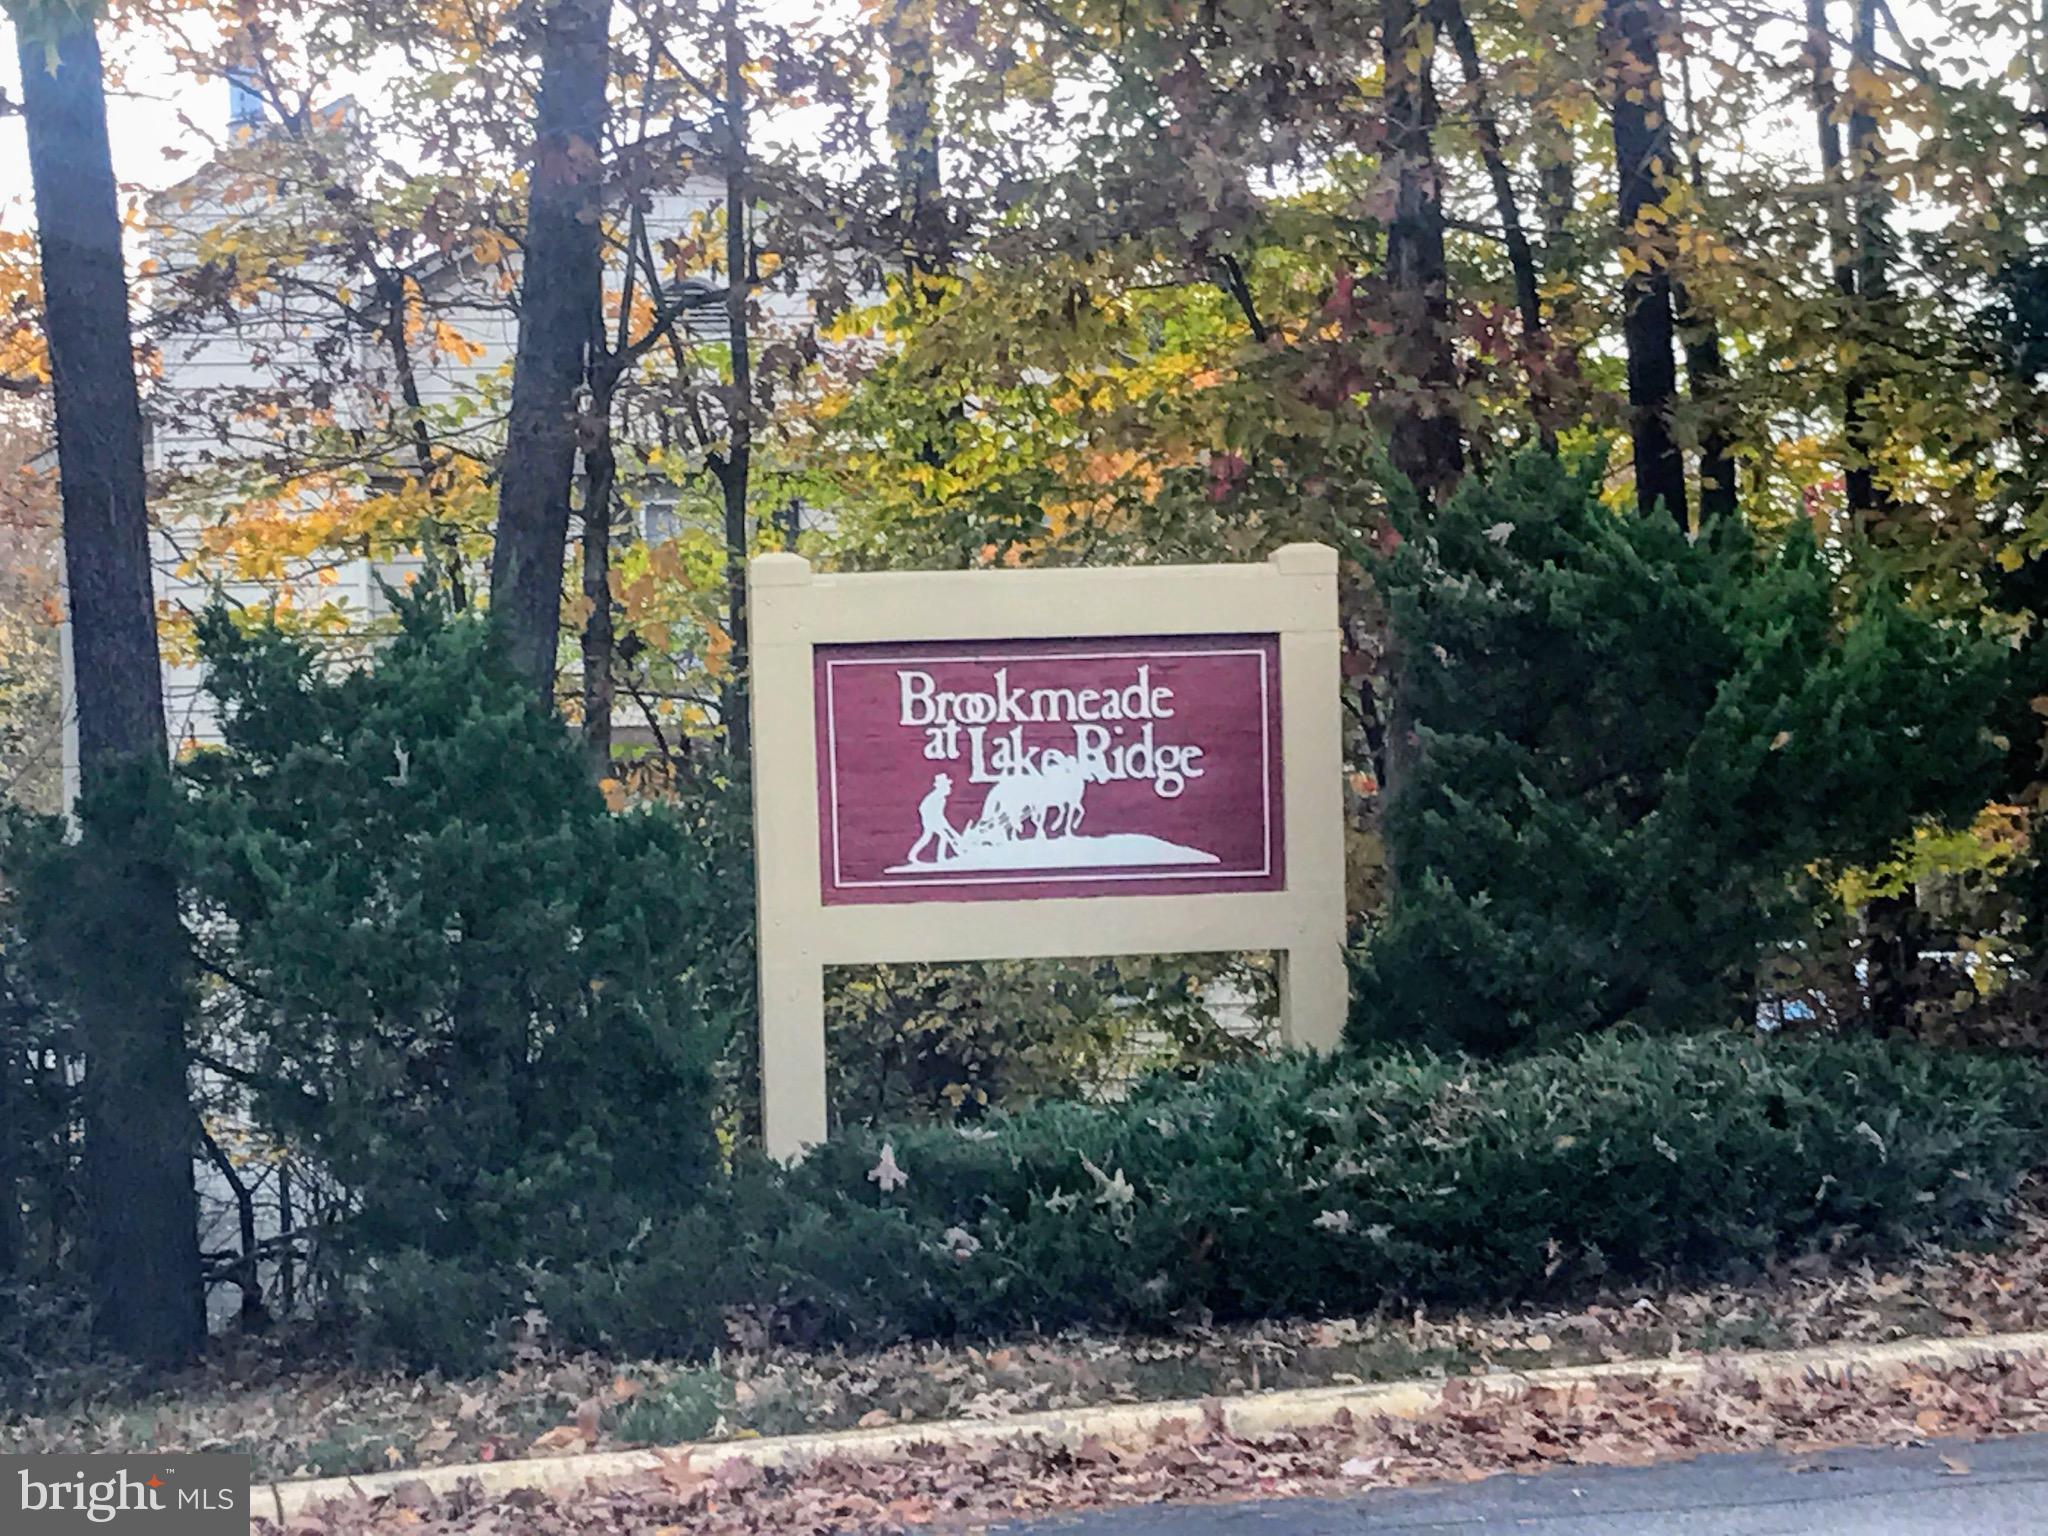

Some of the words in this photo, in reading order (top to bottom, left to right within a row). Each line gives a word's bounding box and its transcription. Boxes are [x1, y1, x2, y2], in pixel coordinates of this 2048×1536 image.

[897, 664, 1175, 726] Brookmeade
[923, 719, 961, 760] at
[1073, 723, 1205, 798] Ridge
